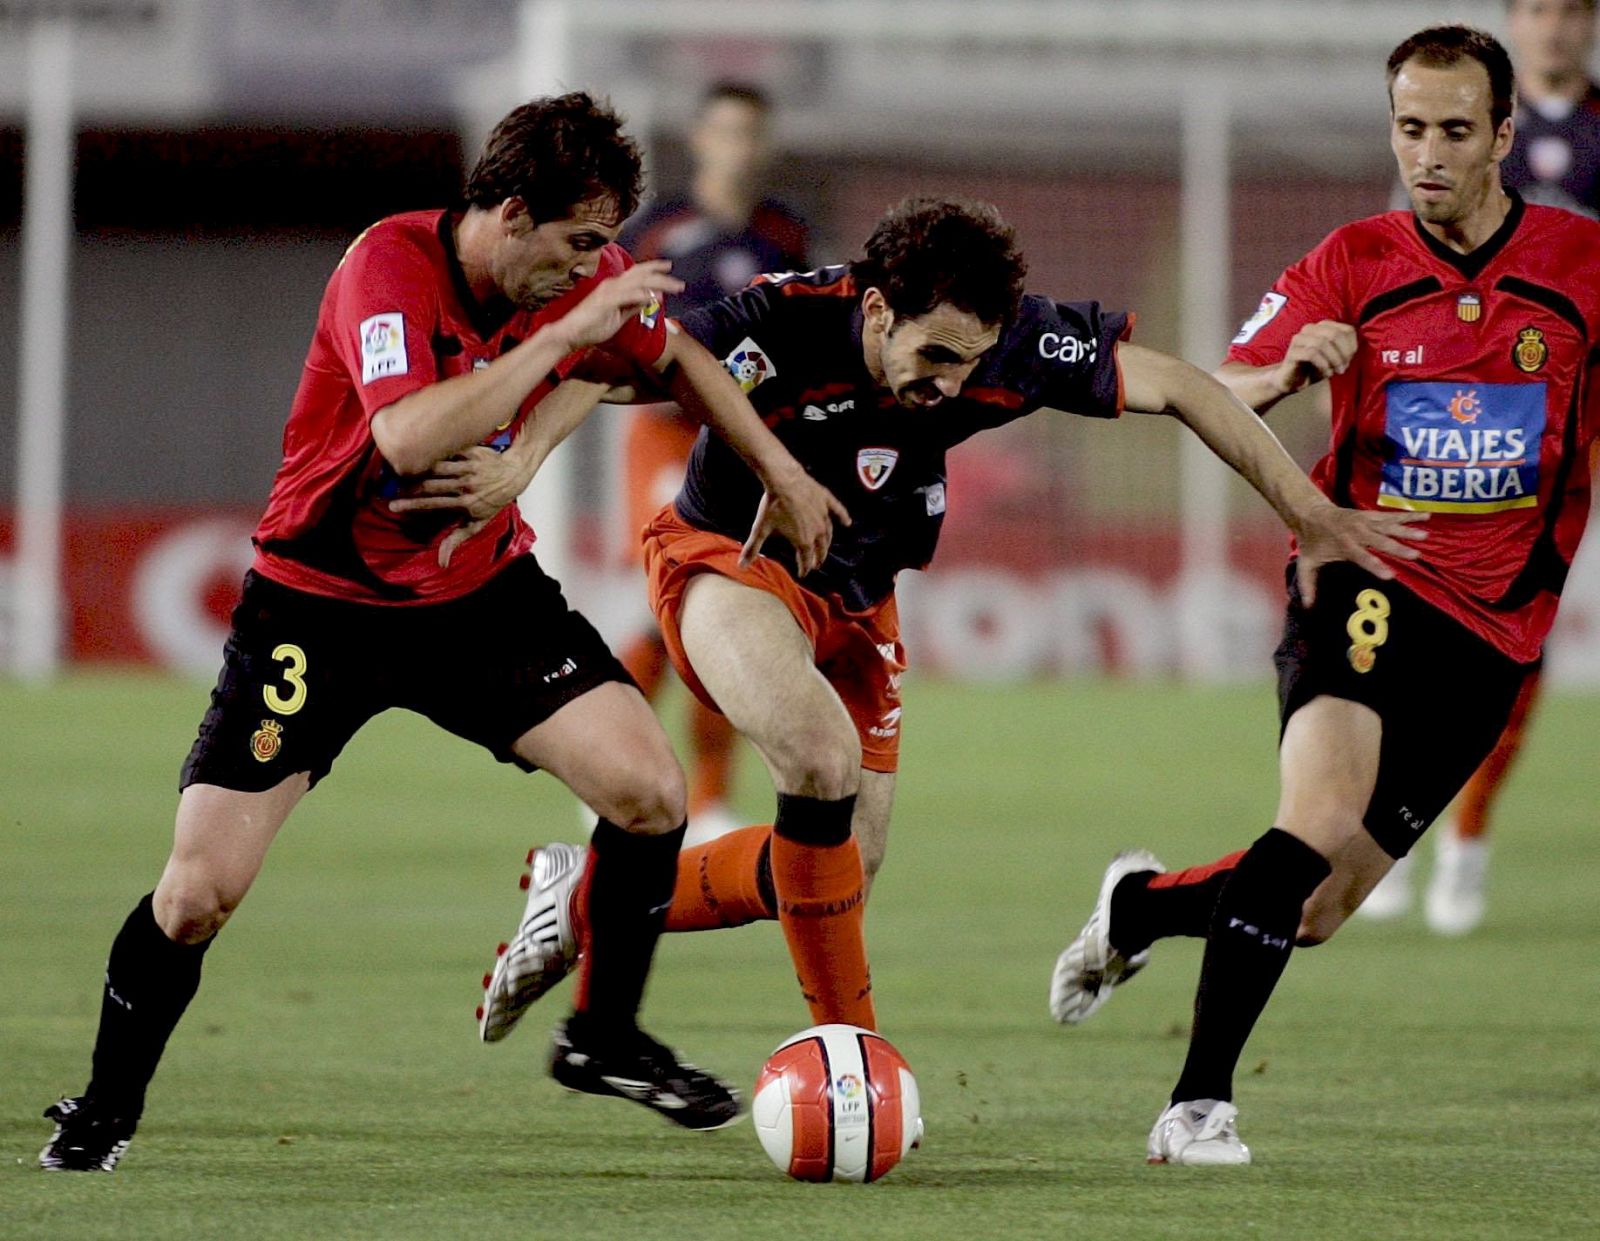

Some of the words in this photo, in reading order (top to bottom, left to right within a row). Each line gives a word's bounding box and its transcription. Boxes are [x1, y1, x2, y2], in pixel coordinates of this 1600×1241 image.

[1401, 427, 1526, 467] VIAJES
[1402, 465, 1524, 499] IBERIA
[1346, 588, 1391, 647] 8
[263, 643, 307, 715] 3
